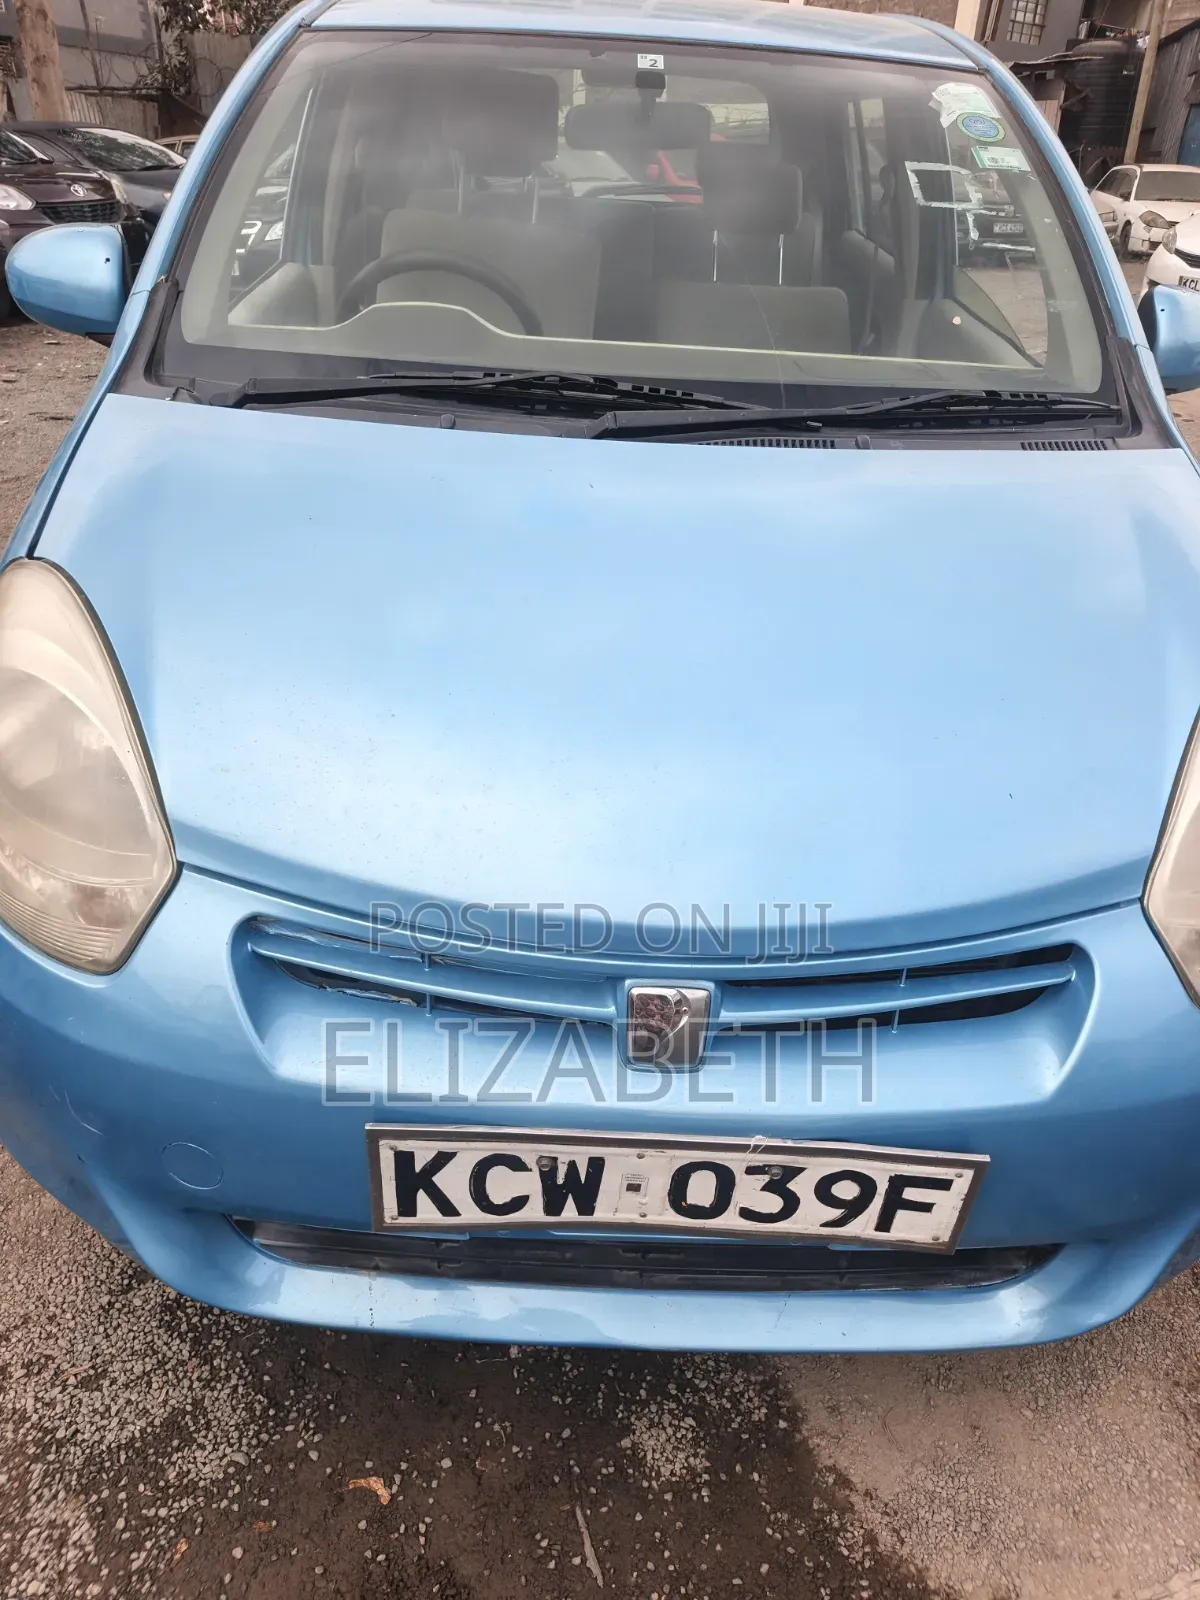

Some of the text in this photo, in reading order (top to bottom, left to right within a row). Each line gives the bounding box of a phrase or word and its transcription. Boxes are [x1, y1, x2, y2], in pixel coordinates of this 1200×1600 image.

[649, 58, 658, 68] 2
[1182, 277, 1200, 292] KCL
[393, 1151, 953, 1234] KCW 039F
